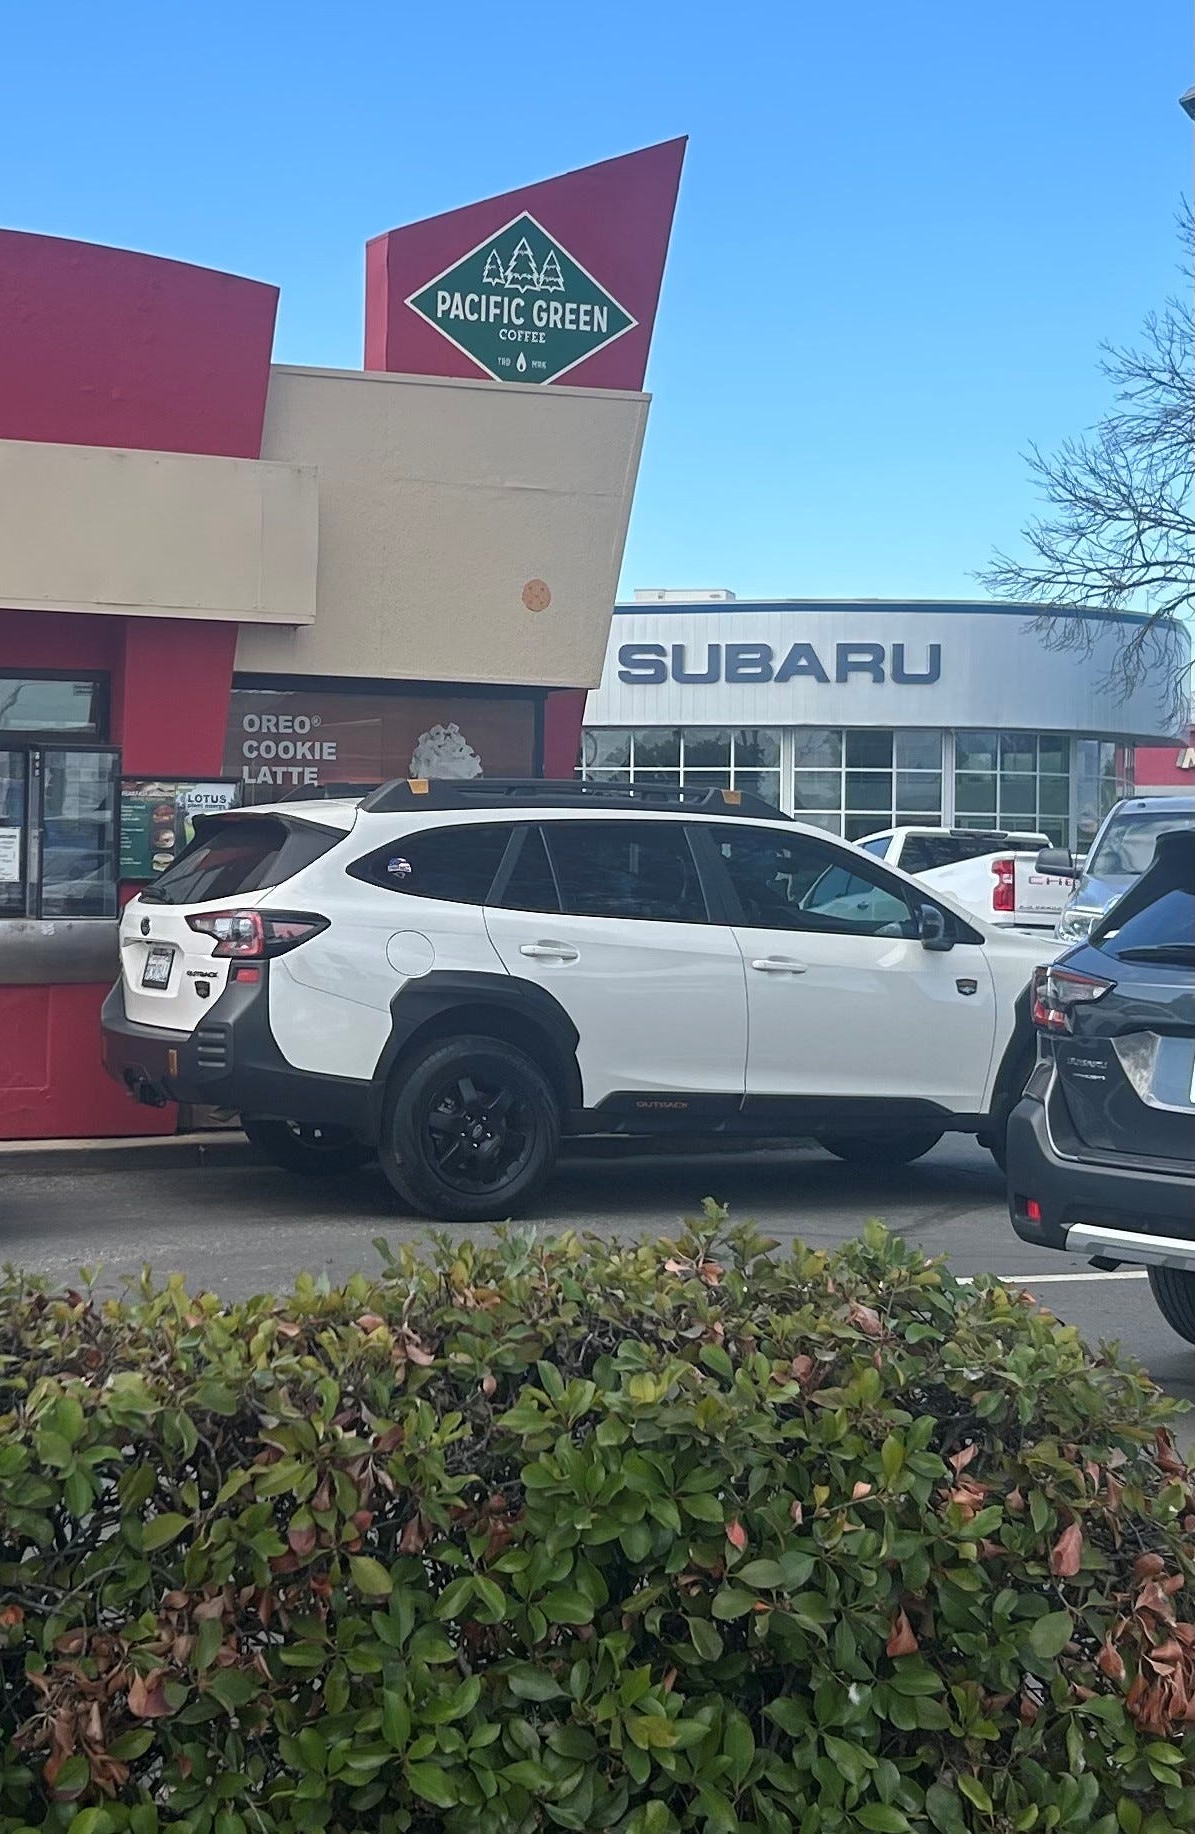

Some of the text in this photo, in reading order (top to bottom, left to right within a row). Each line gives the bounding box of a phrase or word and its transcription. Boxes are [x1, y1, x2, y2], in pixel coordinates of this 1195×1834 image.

[436, 290, 608, 333] PACIFIC GREEN
[498, 328, 547, 344] COFFEE
[617, 642, 942, 685] SUBARU
[242, 740, 337, 760] COOKIE
[242, 765, 318, 787] LATTE
[187, 794, 227, 804] LOTUS
